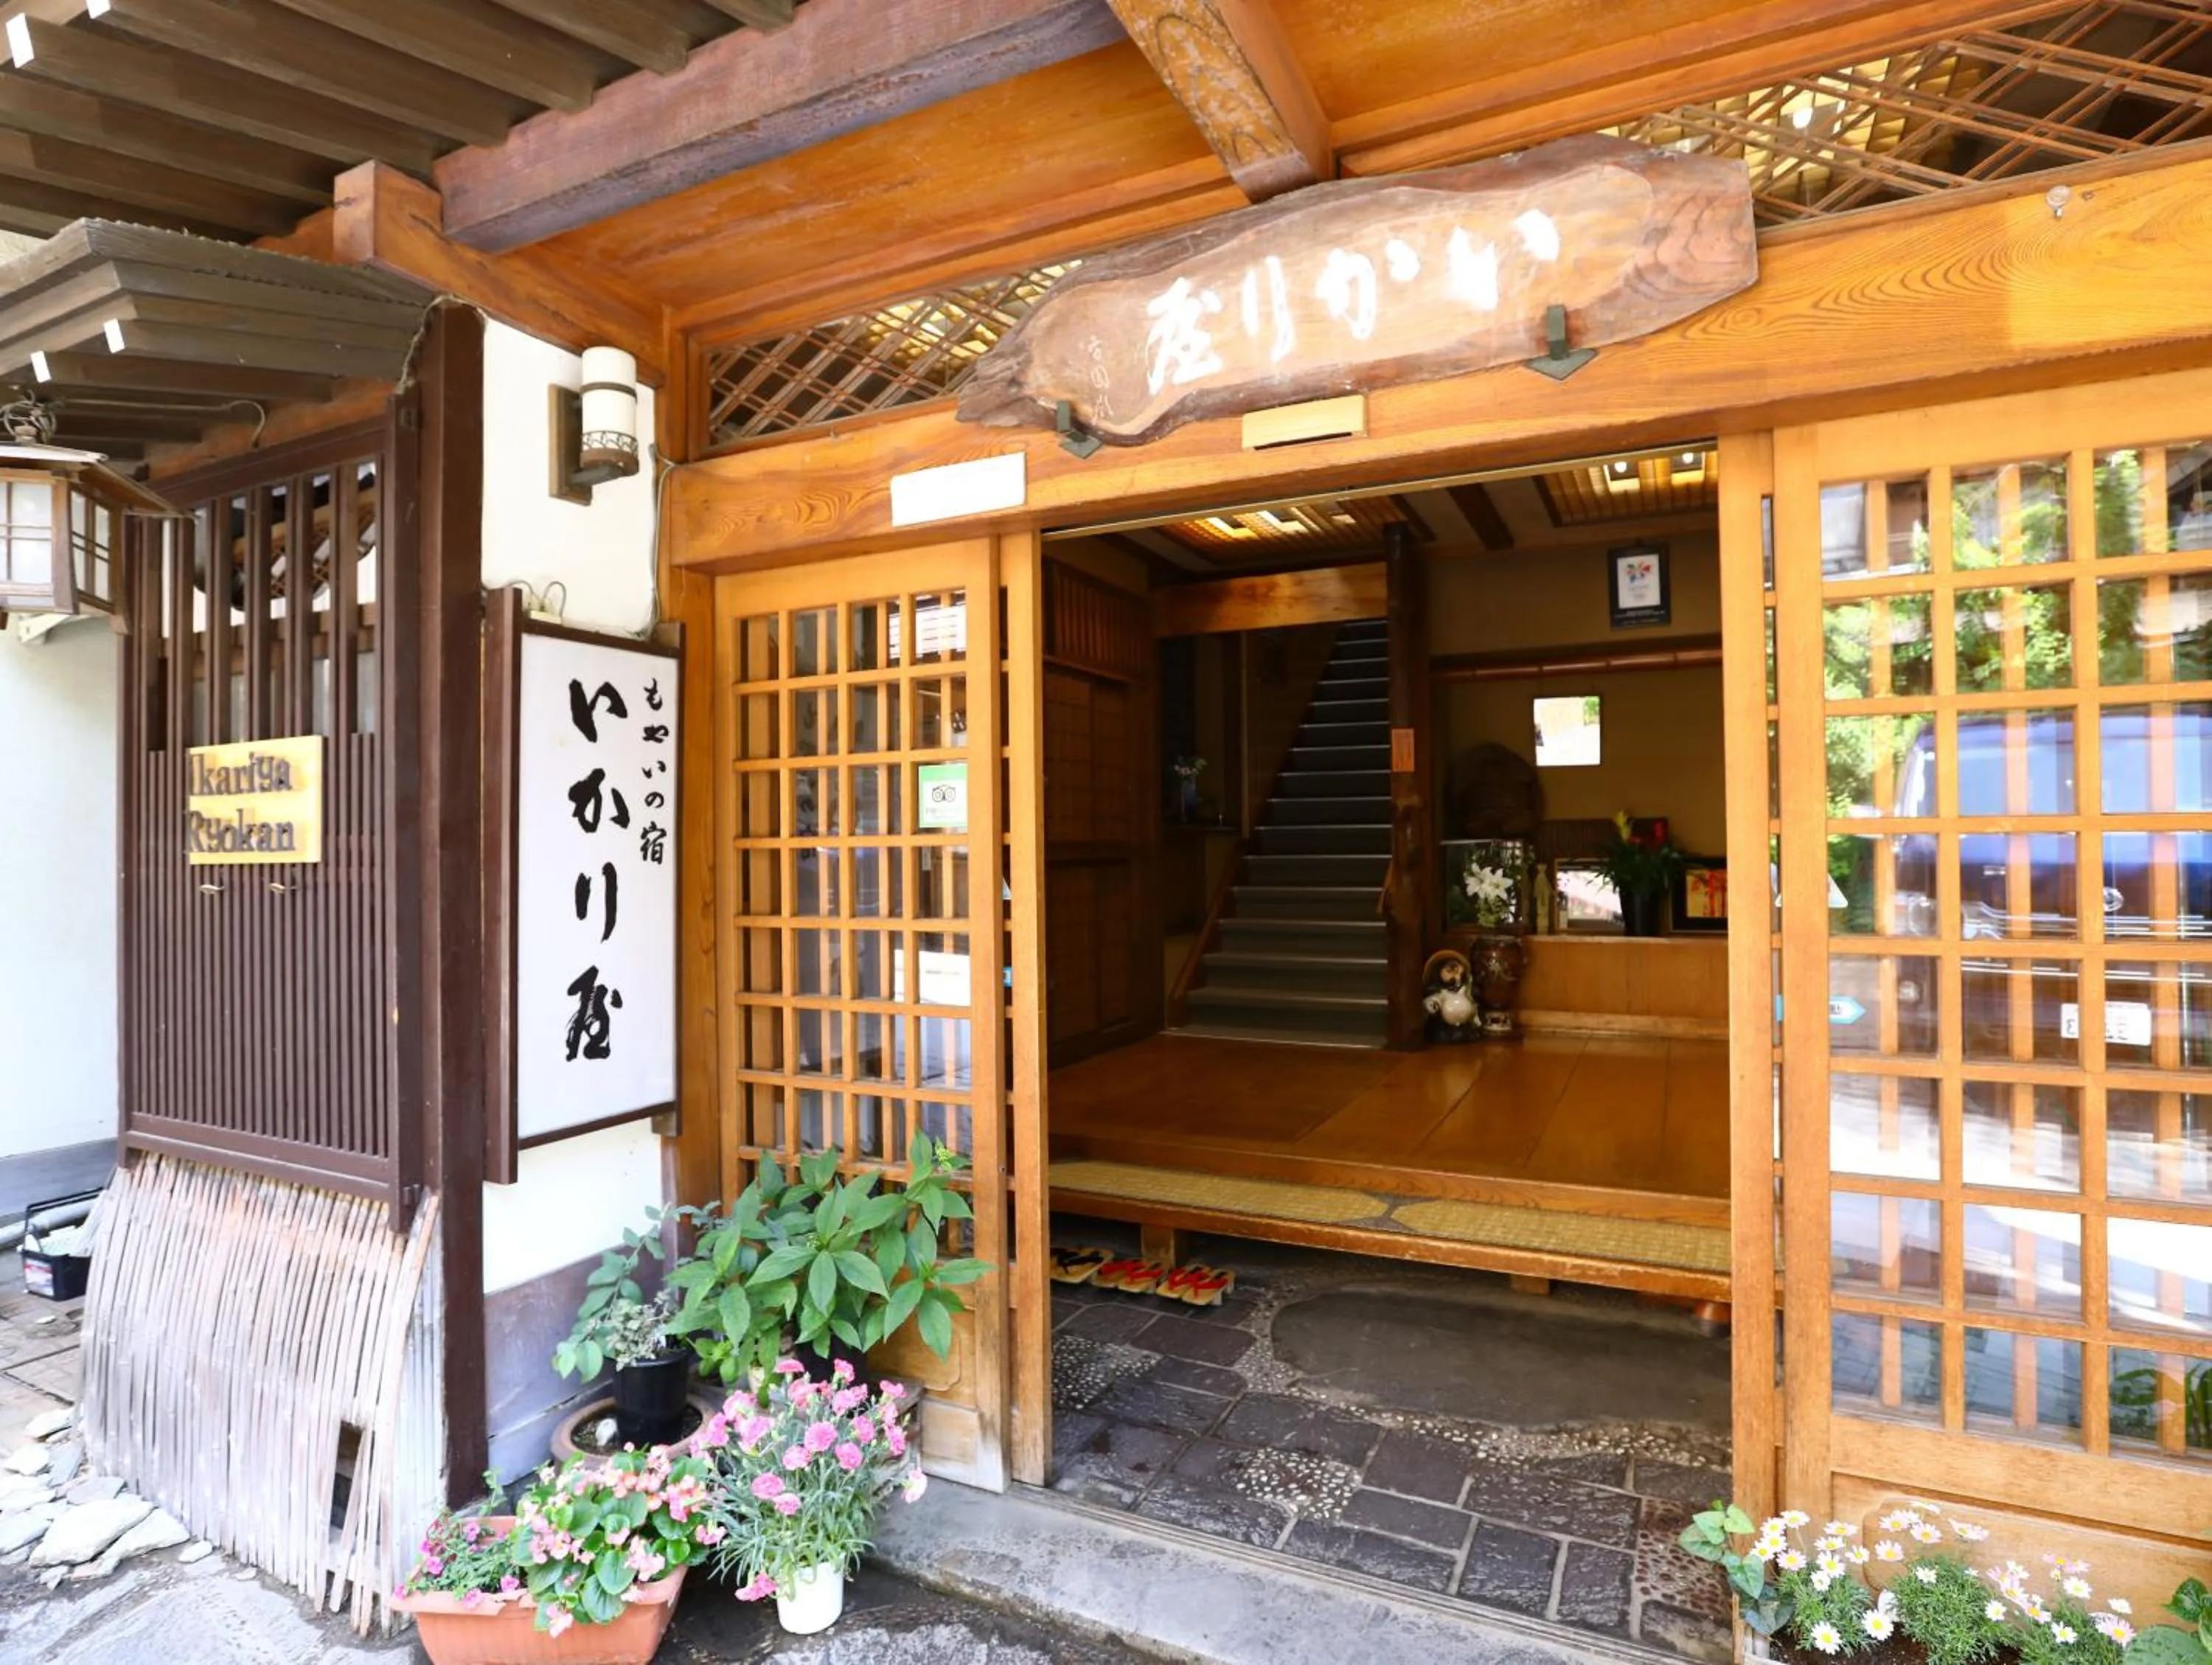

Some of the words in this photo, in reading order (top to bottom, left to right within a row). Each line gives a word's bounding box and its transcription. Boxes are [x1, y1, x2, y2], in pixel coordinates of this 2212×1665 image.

[187, 751, 293, 796] Ikariya
[639, 678, 669, 866] もやいの宿
[185, 808, 296, 853] Ryokan
[566, 678, 630, 1063] いかり屋
